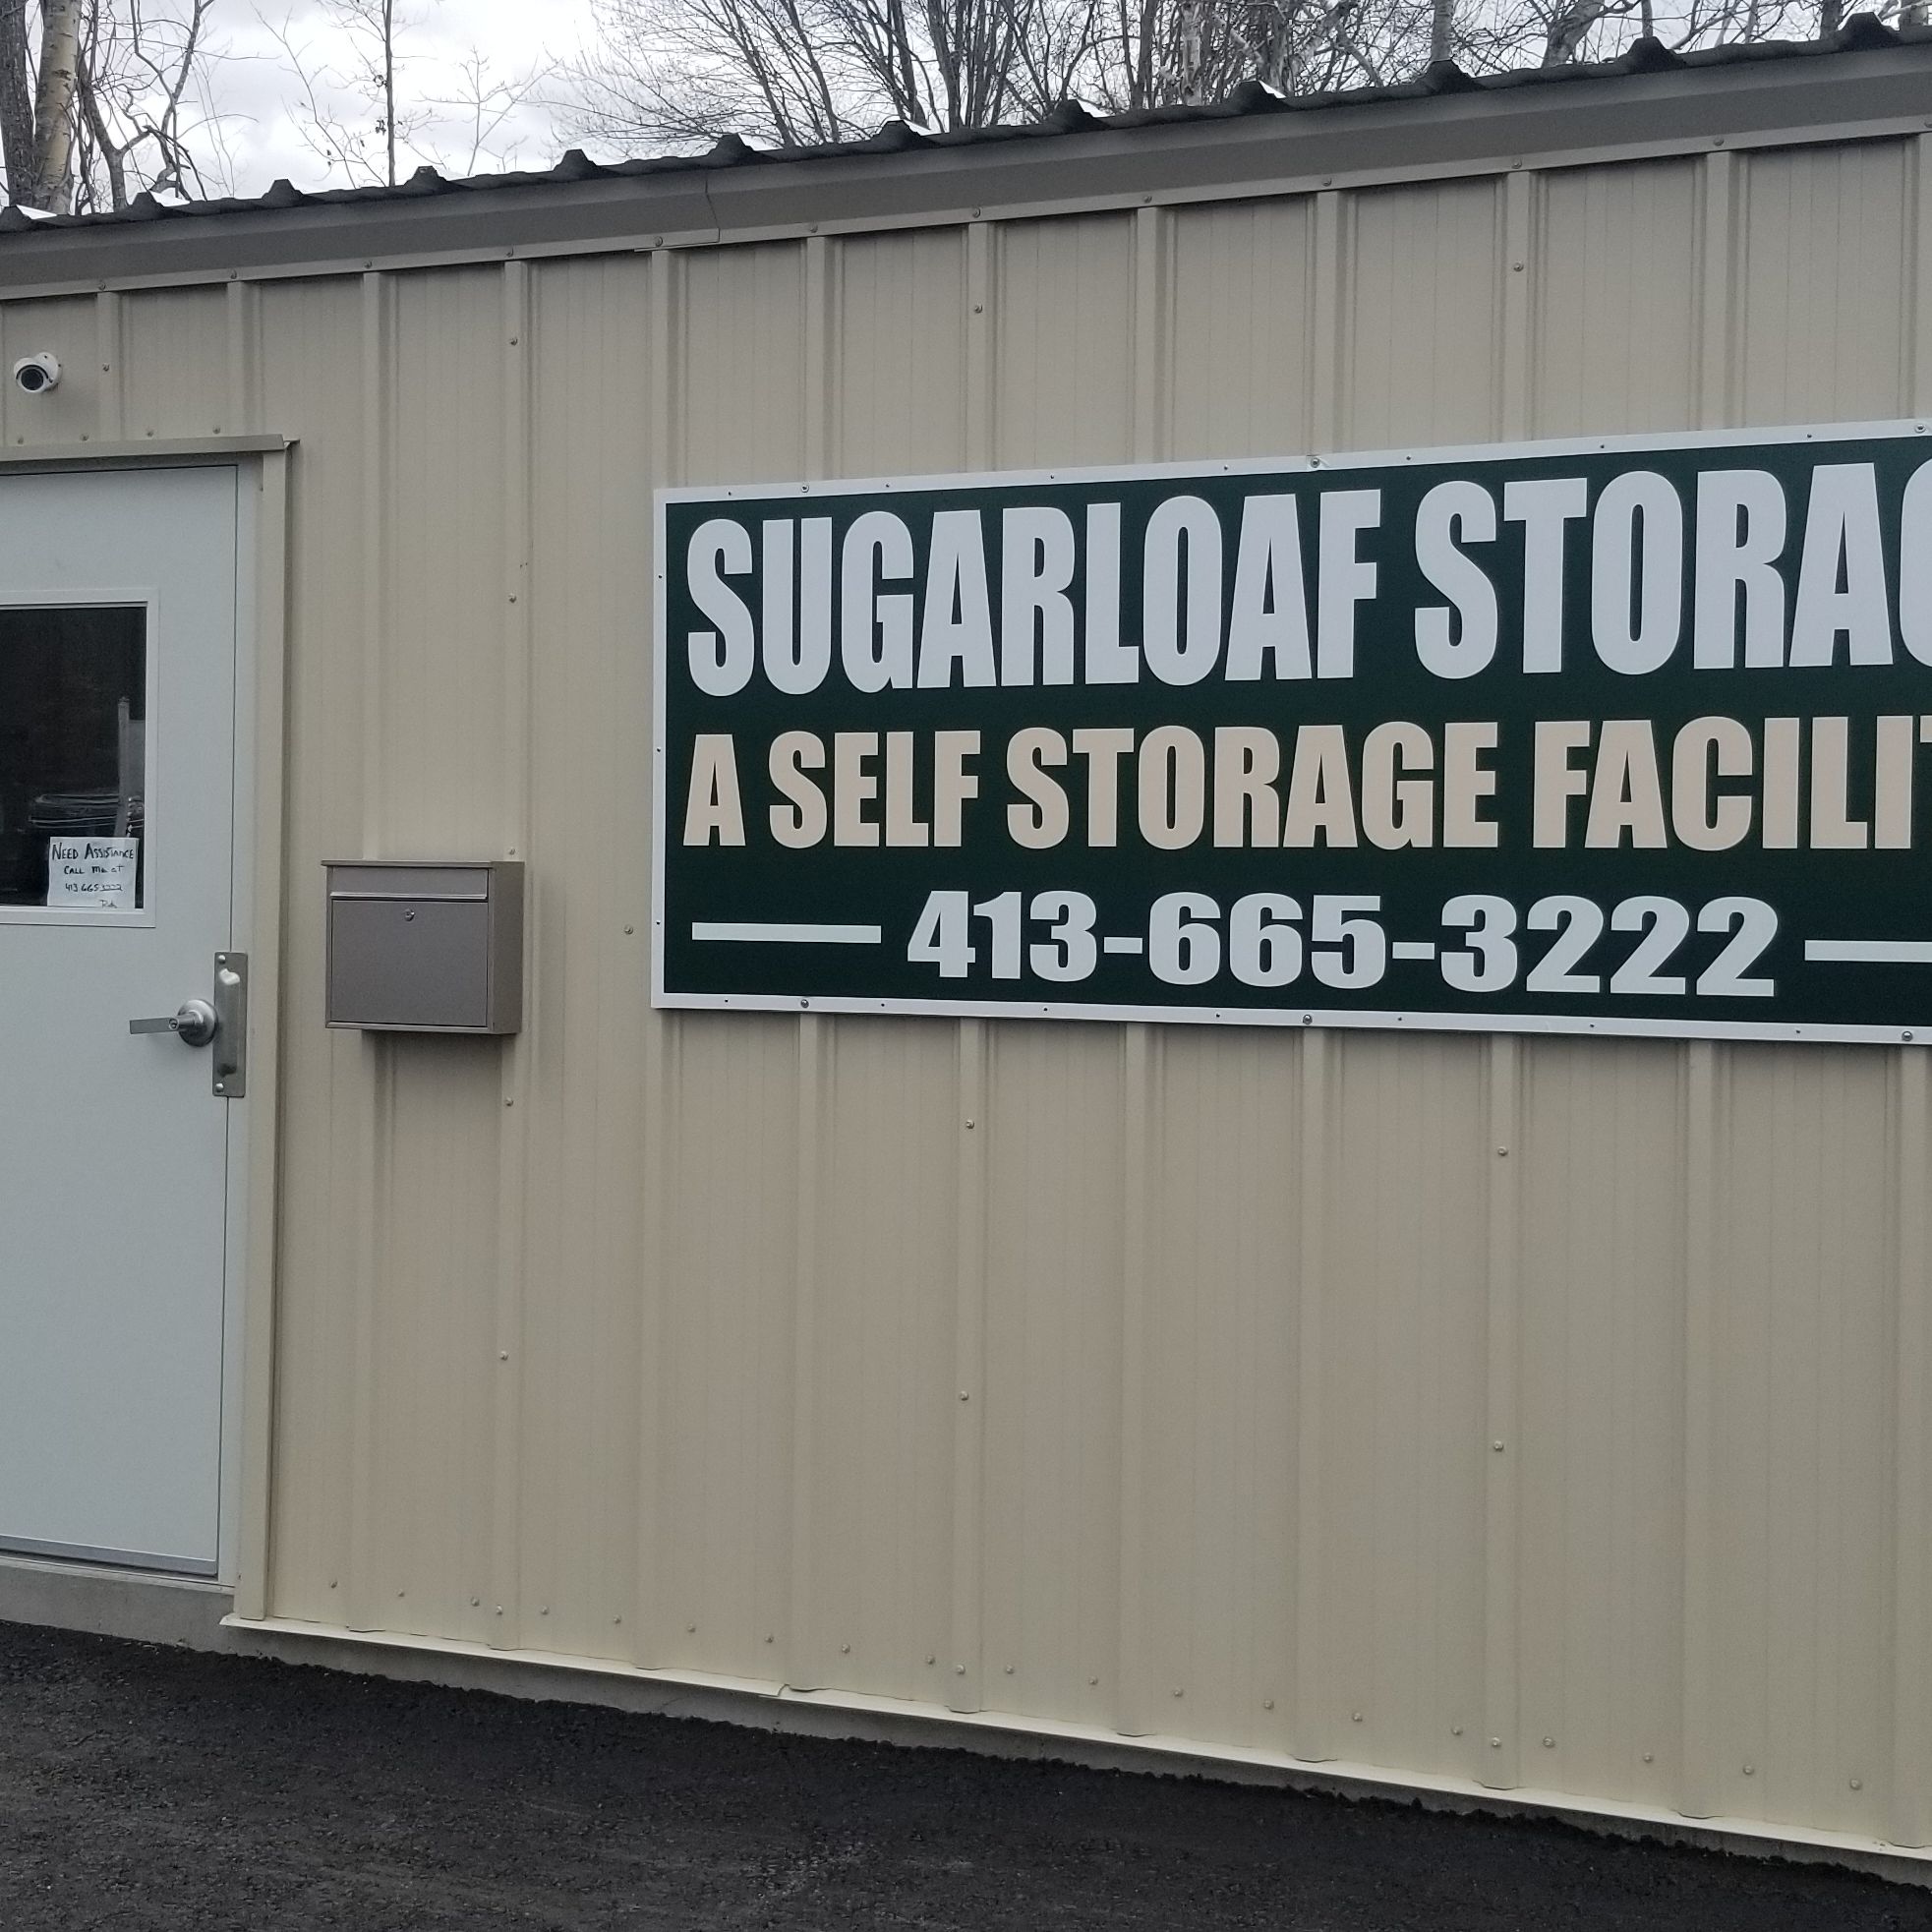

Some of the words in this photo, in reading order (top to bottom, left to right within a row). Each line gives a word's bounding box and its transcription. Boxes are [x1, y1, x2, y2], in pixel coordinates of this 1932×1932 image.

[687, 489, 1380, 696] SUGARLOAF
[683, 734, 745, 848] A
[769, 730, 980, 849] SELF
[1007, 723, 1498, 849] STORAGE
[1534, 716, 1932, 850] FACILI
[52, 842, 79, 860] NEED
[907, 891, 1778, 996] 413-665-3222
